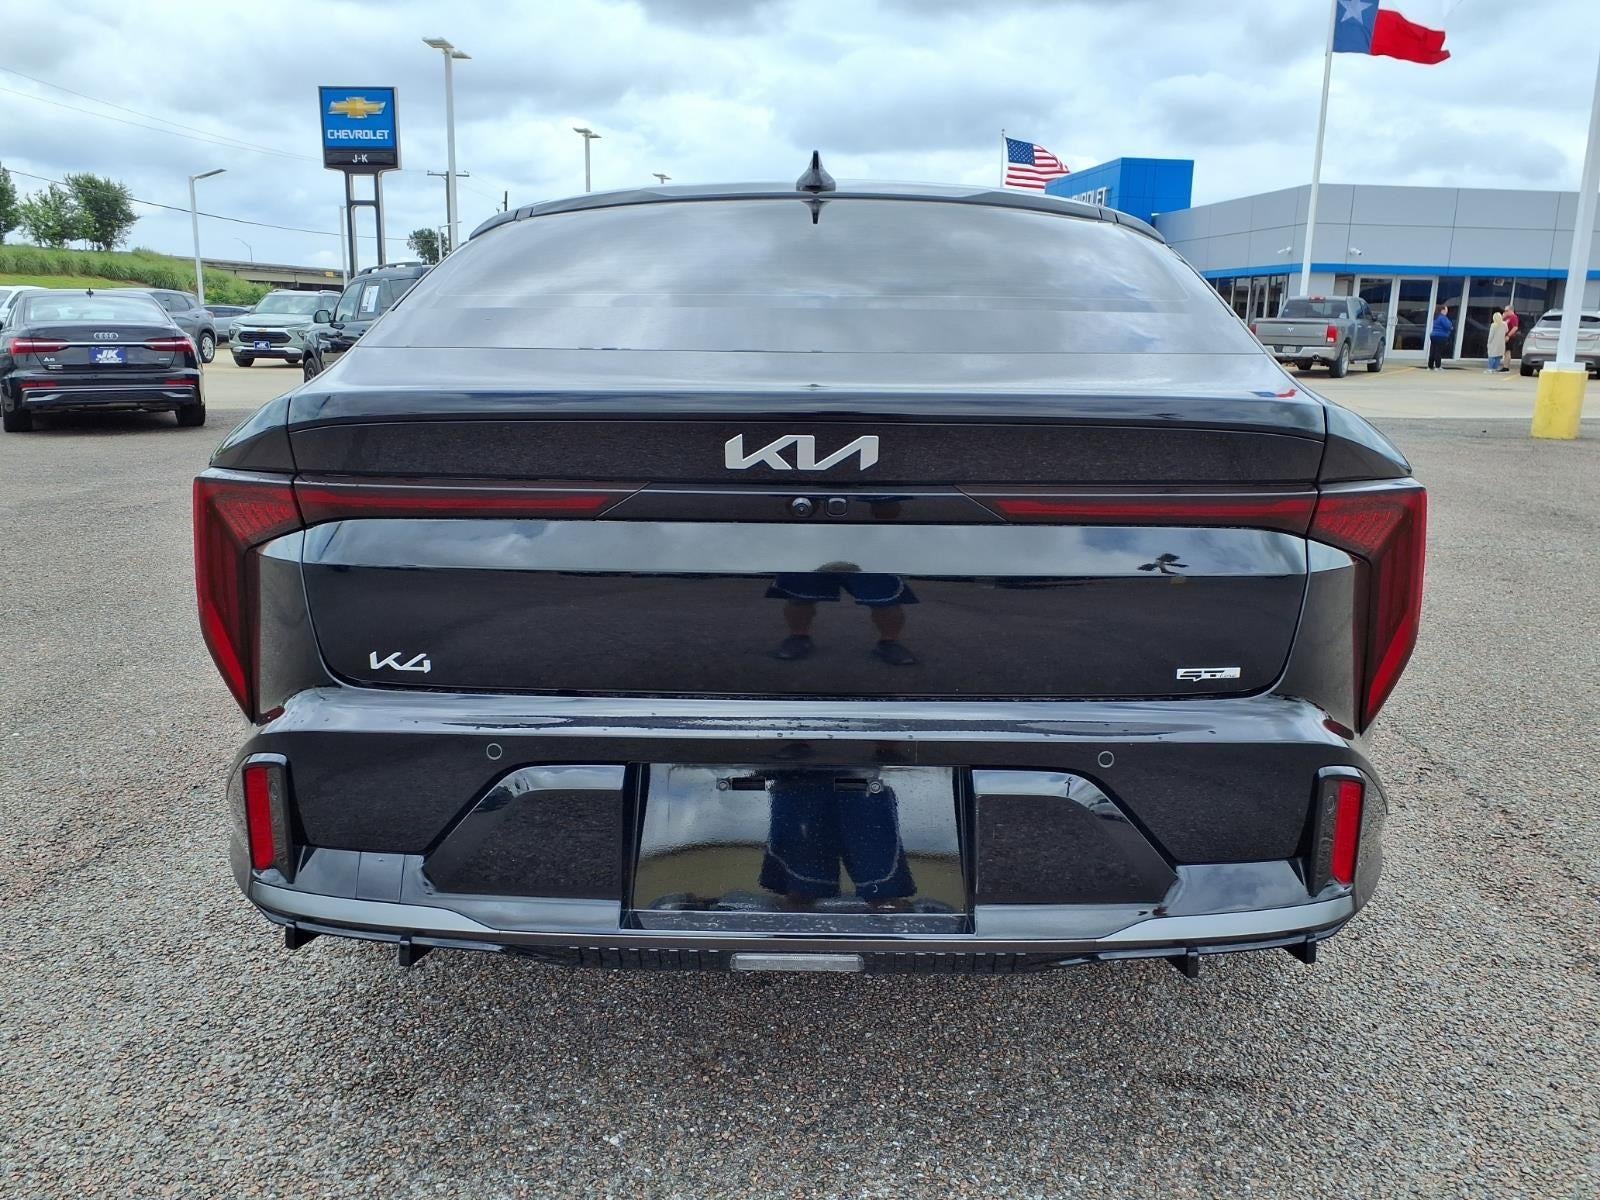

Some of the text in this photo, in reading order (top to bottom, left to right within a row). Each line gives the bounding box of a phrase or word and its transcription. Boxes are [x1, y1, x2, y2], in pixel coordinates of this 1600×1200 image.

[327, 129, 390, 140] CHEVROLET
[352, 154, 369, 163] J-K
[725, 433, 880, 471] KIA
[369, 650, 432, 674] K4
